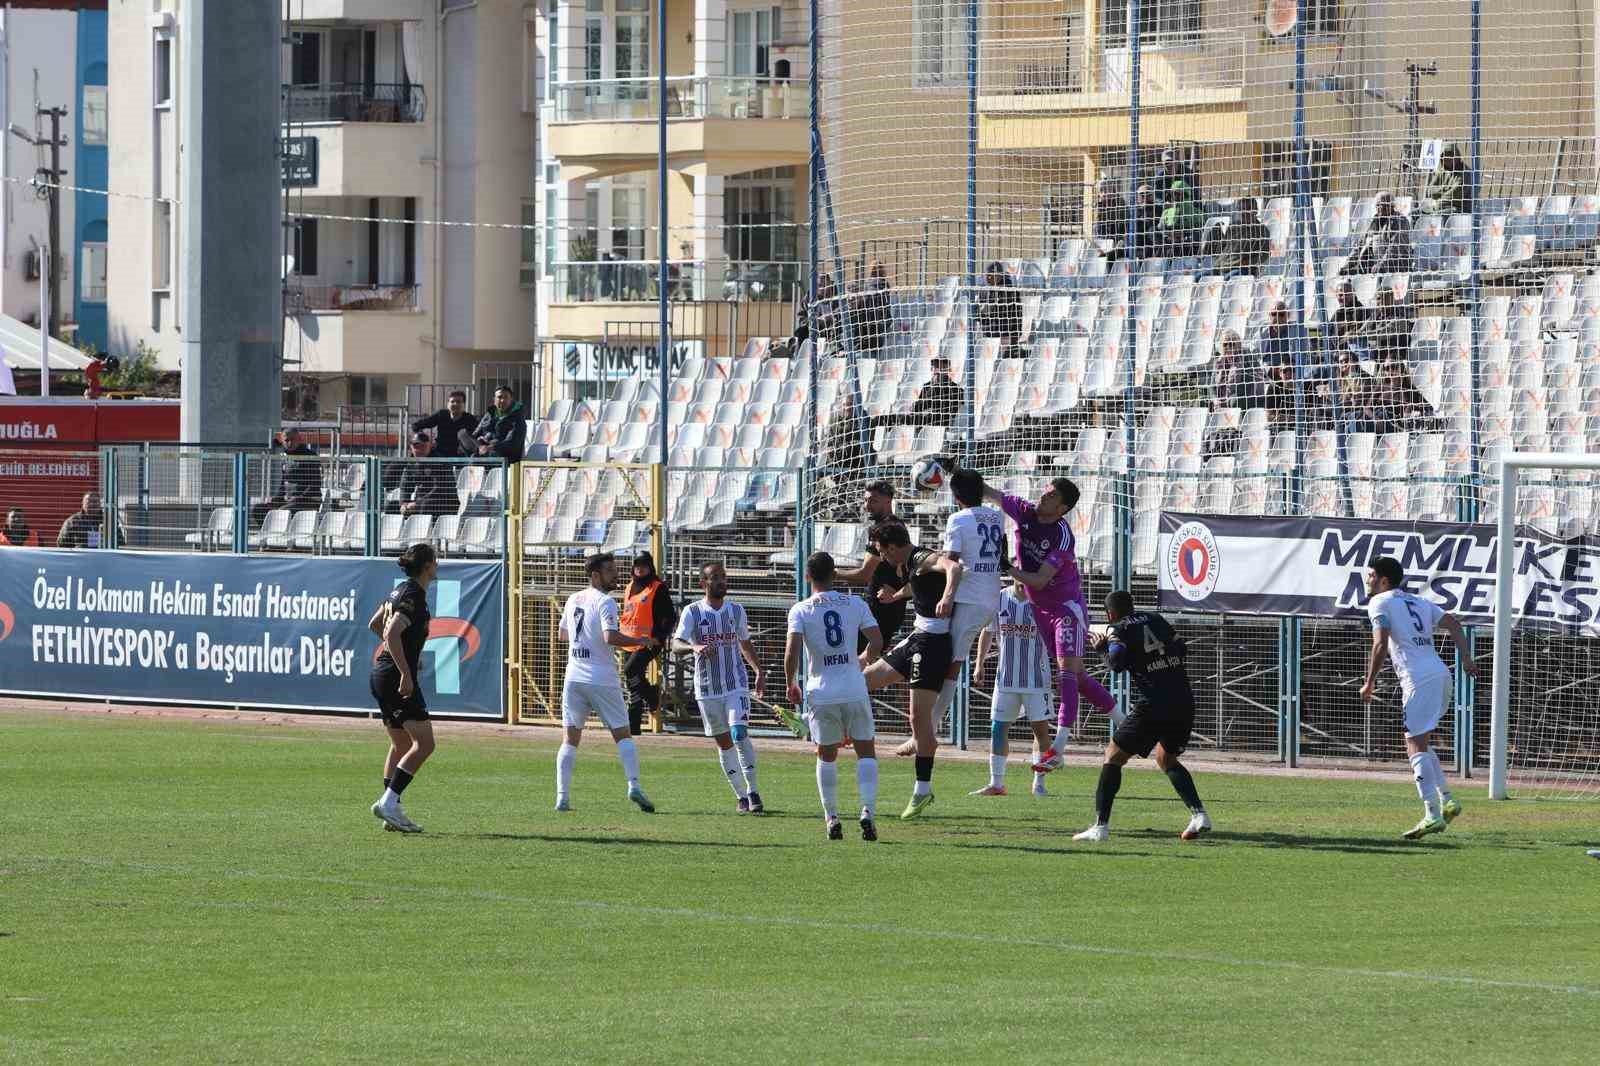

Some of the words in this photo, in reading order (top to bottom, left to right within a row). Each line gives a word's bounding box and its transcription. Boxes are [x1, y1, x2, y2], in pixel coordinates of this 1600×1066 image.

[28, 460, 91, 477] BELEDİYESİ
[33, 568, 72, 610] Özel
[77, 577, 144, 613] Lokman
[149, 580, 206, 616] Hekim
[213, 582, 262, 618] Esnaf
[266, 584, 356, 621] Hastanesi
[573, 606, 585, 642] 7
[823, 610, 843, 648] 8
[1404, 599, 1425, 633] 5
[195, 631, 293, 683] Başarılar
[300, 634, 354, 676] Diler
[1143, 625, 1165, 655] 4
[823, 652, 849, 667] İRFAN
